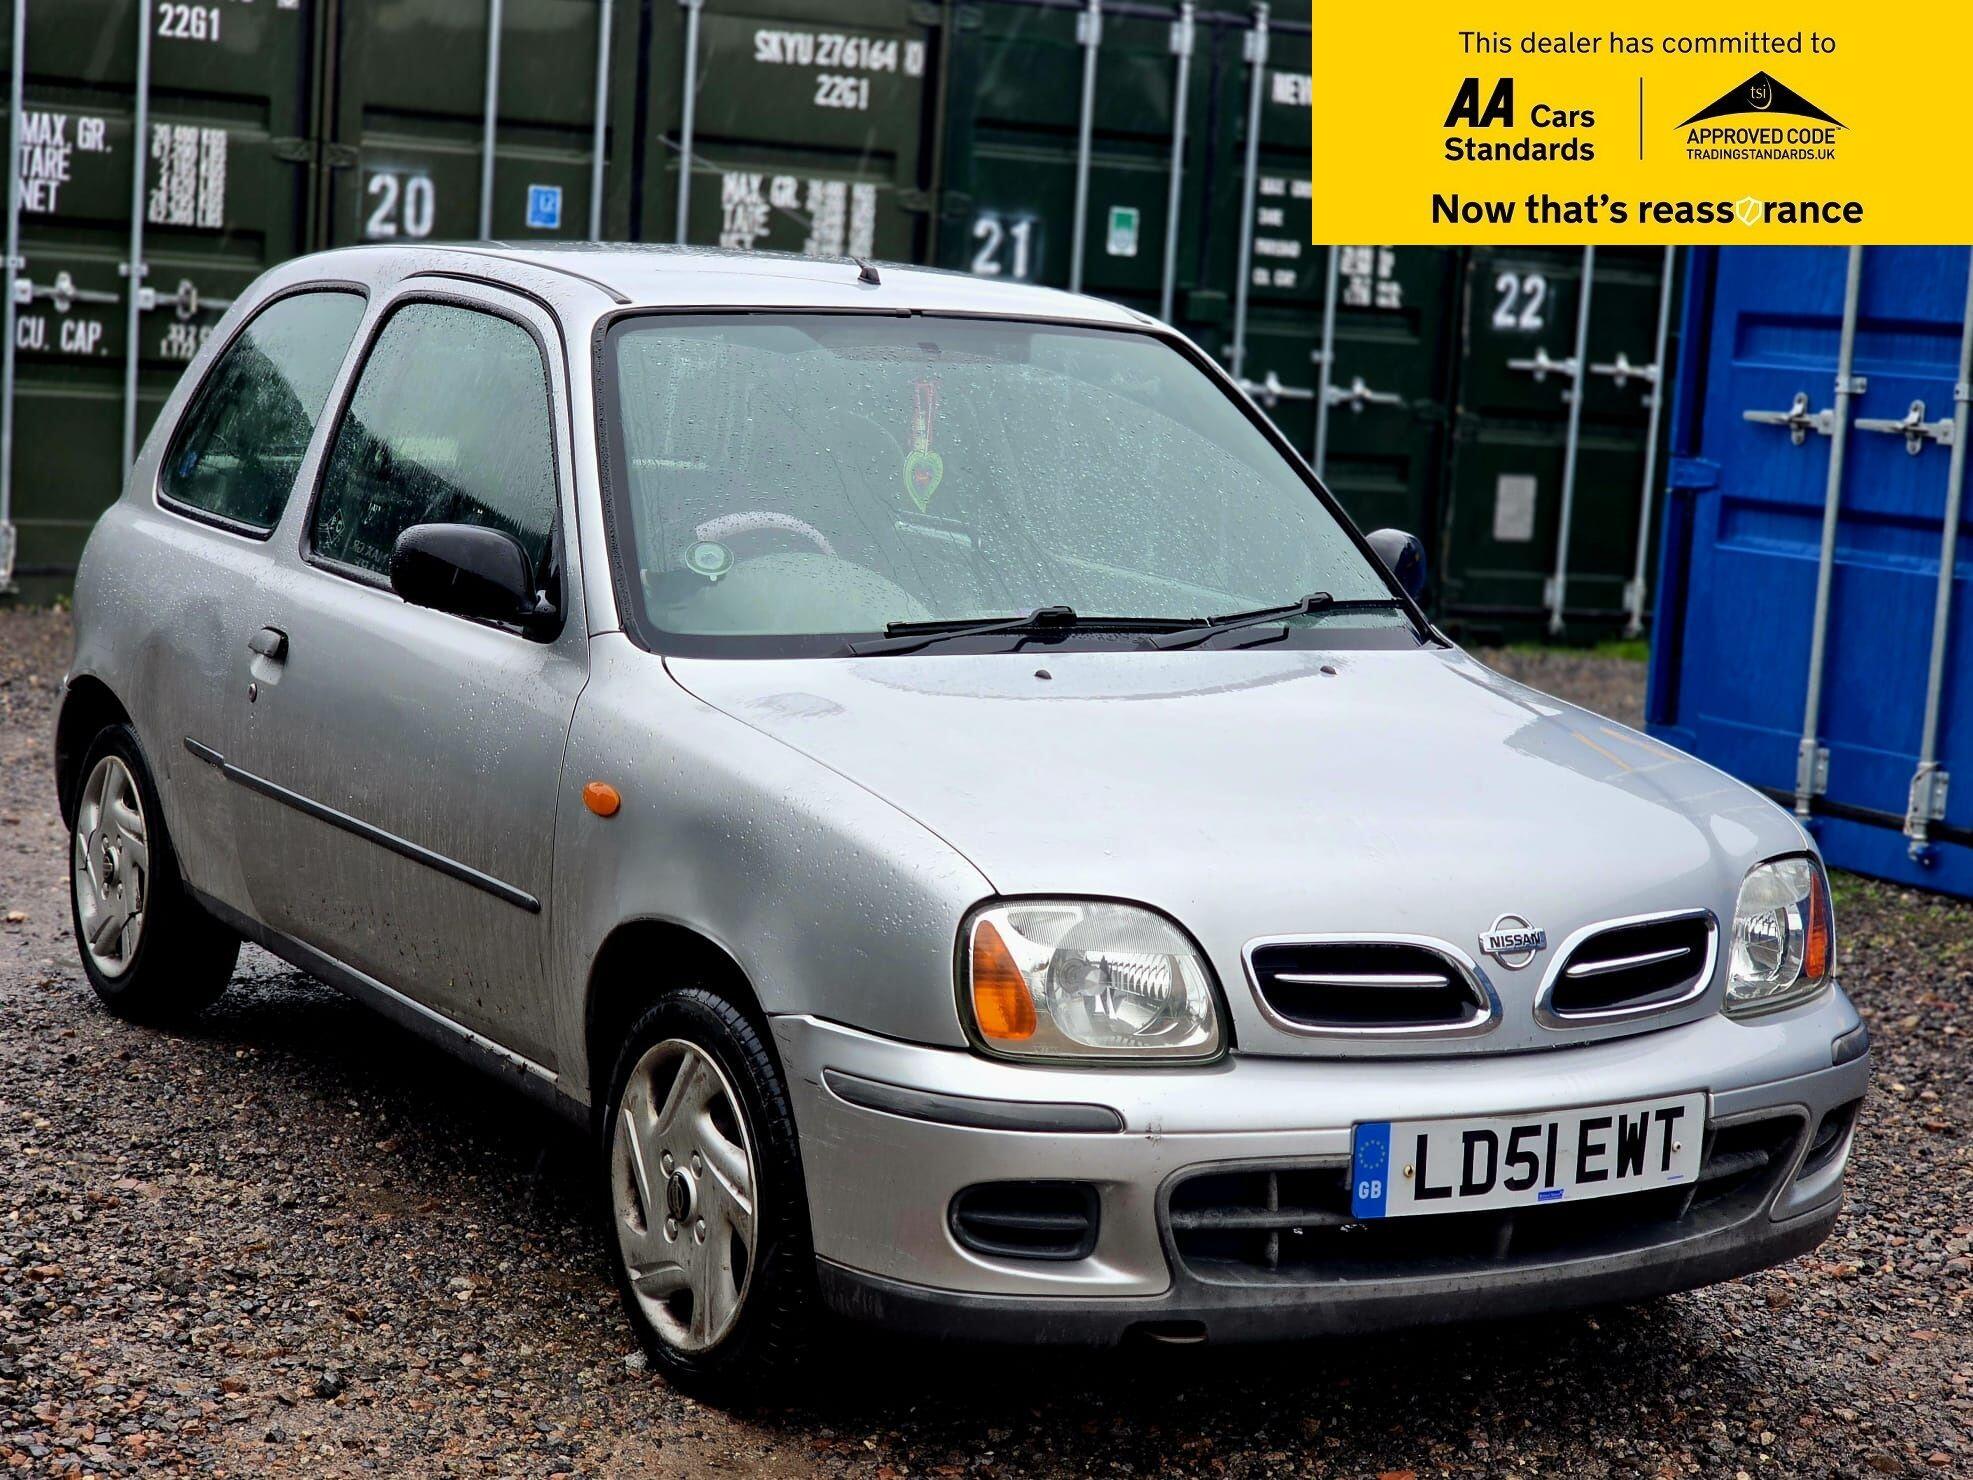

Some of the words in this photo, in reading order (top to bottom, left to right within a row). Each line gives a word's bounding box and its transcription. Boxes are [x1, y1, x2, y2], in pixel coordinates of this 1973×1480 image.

[158, 3, 220, 41] 22G1
[755, 29, 814, 66] SKYU
[815, 33, 898, 72] 276164
[20, 146, 71, 181] TARE
[366, 174, 435, 238] 20
[972, 219, 1031, 278] 21
[1493, 273, 1546, 329] 22
[17, 316, 50, 351] CU.
[61, 319, 108, 357] CAP.
[1490, 932, 1541, 948] NISSAN
[1414, 1123, 1559, 1201] LD51
[1575, 1106, 1685, 1185] EWT
[1358, 1180, 1382, 1199] GB
